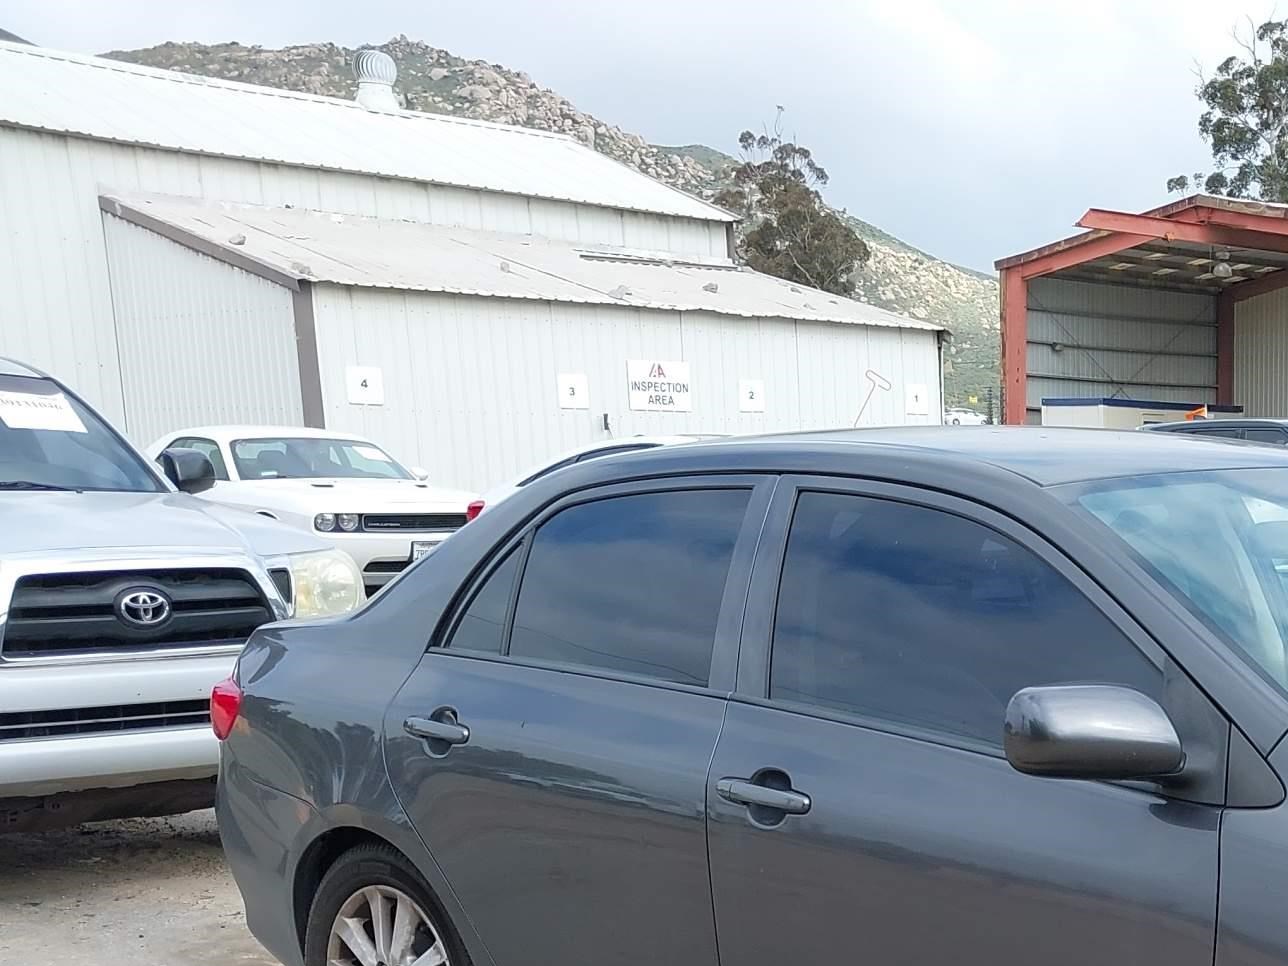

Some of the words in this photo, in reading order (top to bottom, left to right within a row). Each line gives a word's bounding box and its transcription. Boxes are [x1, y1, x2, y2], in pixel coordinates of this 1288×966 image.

[360, 378, 368, 388] 4
[631, 380, 689, 393] INSPECTION
[569, 386, 575, 396] 3
[748, 391, 755, 400] 2
[648, 394, 675, 406] AREA
